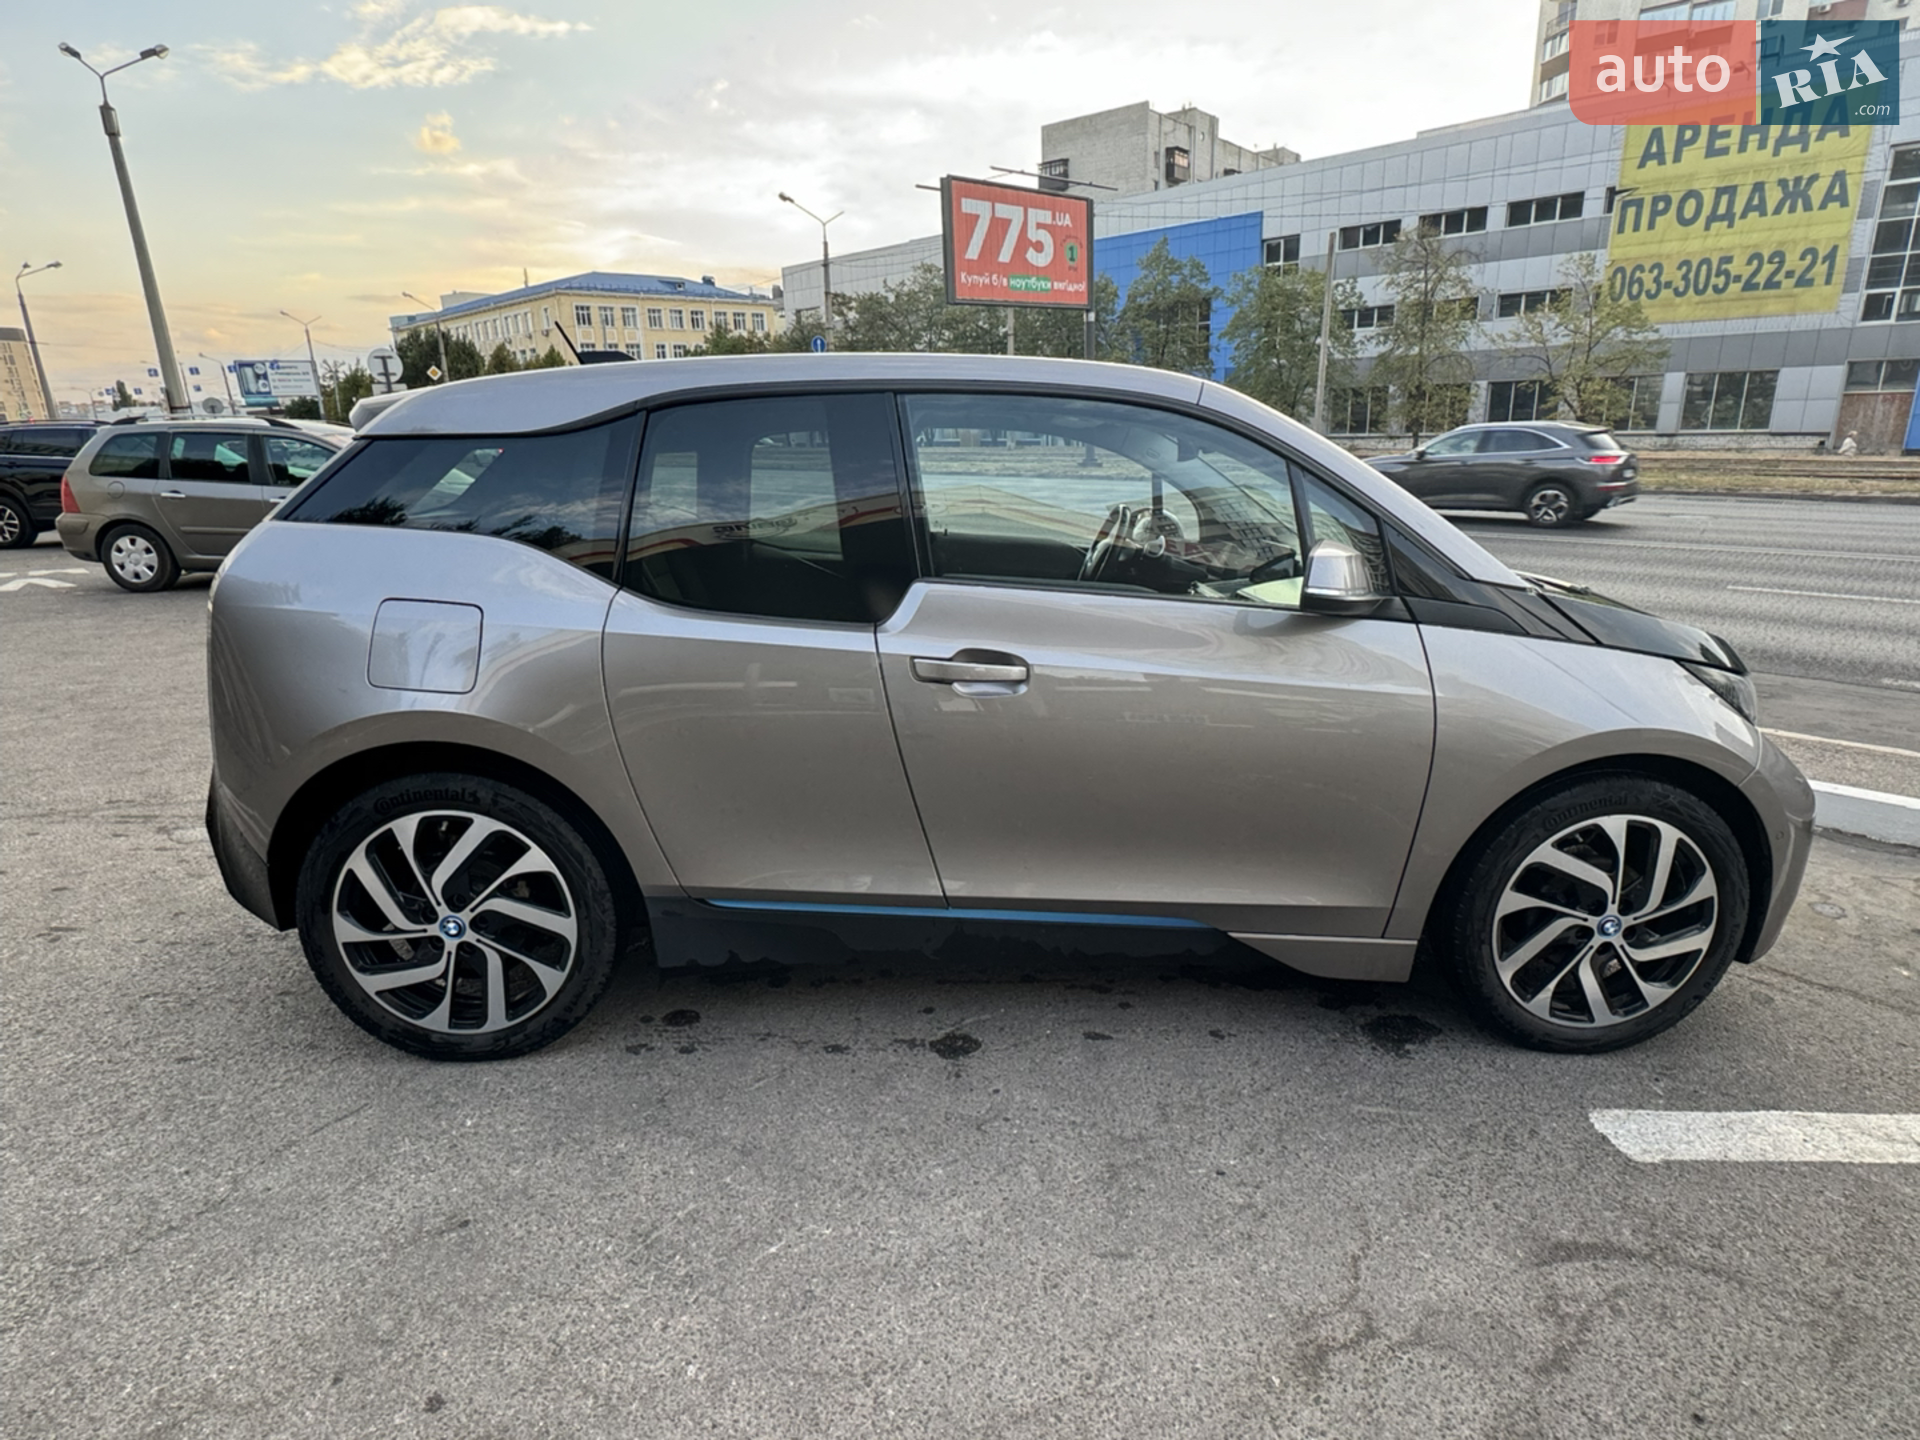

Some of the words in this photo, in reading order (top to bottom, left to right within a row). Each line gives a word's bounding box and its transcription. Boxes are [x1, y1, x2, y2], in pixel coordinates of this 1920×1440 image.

[1637, 94, 1850, 169] АРЕНДА
[1617, 170, 1850, 234] ПРОДАЖА
[960, 271, 990, 288] Купуй
[992, 273, 1008, 288] б/в
[1009, 276, 1051, 291] ноутбуки
[1610, 244, 1840, 303] 063-305-22-21
[373, 787, 466, 815] Continental
